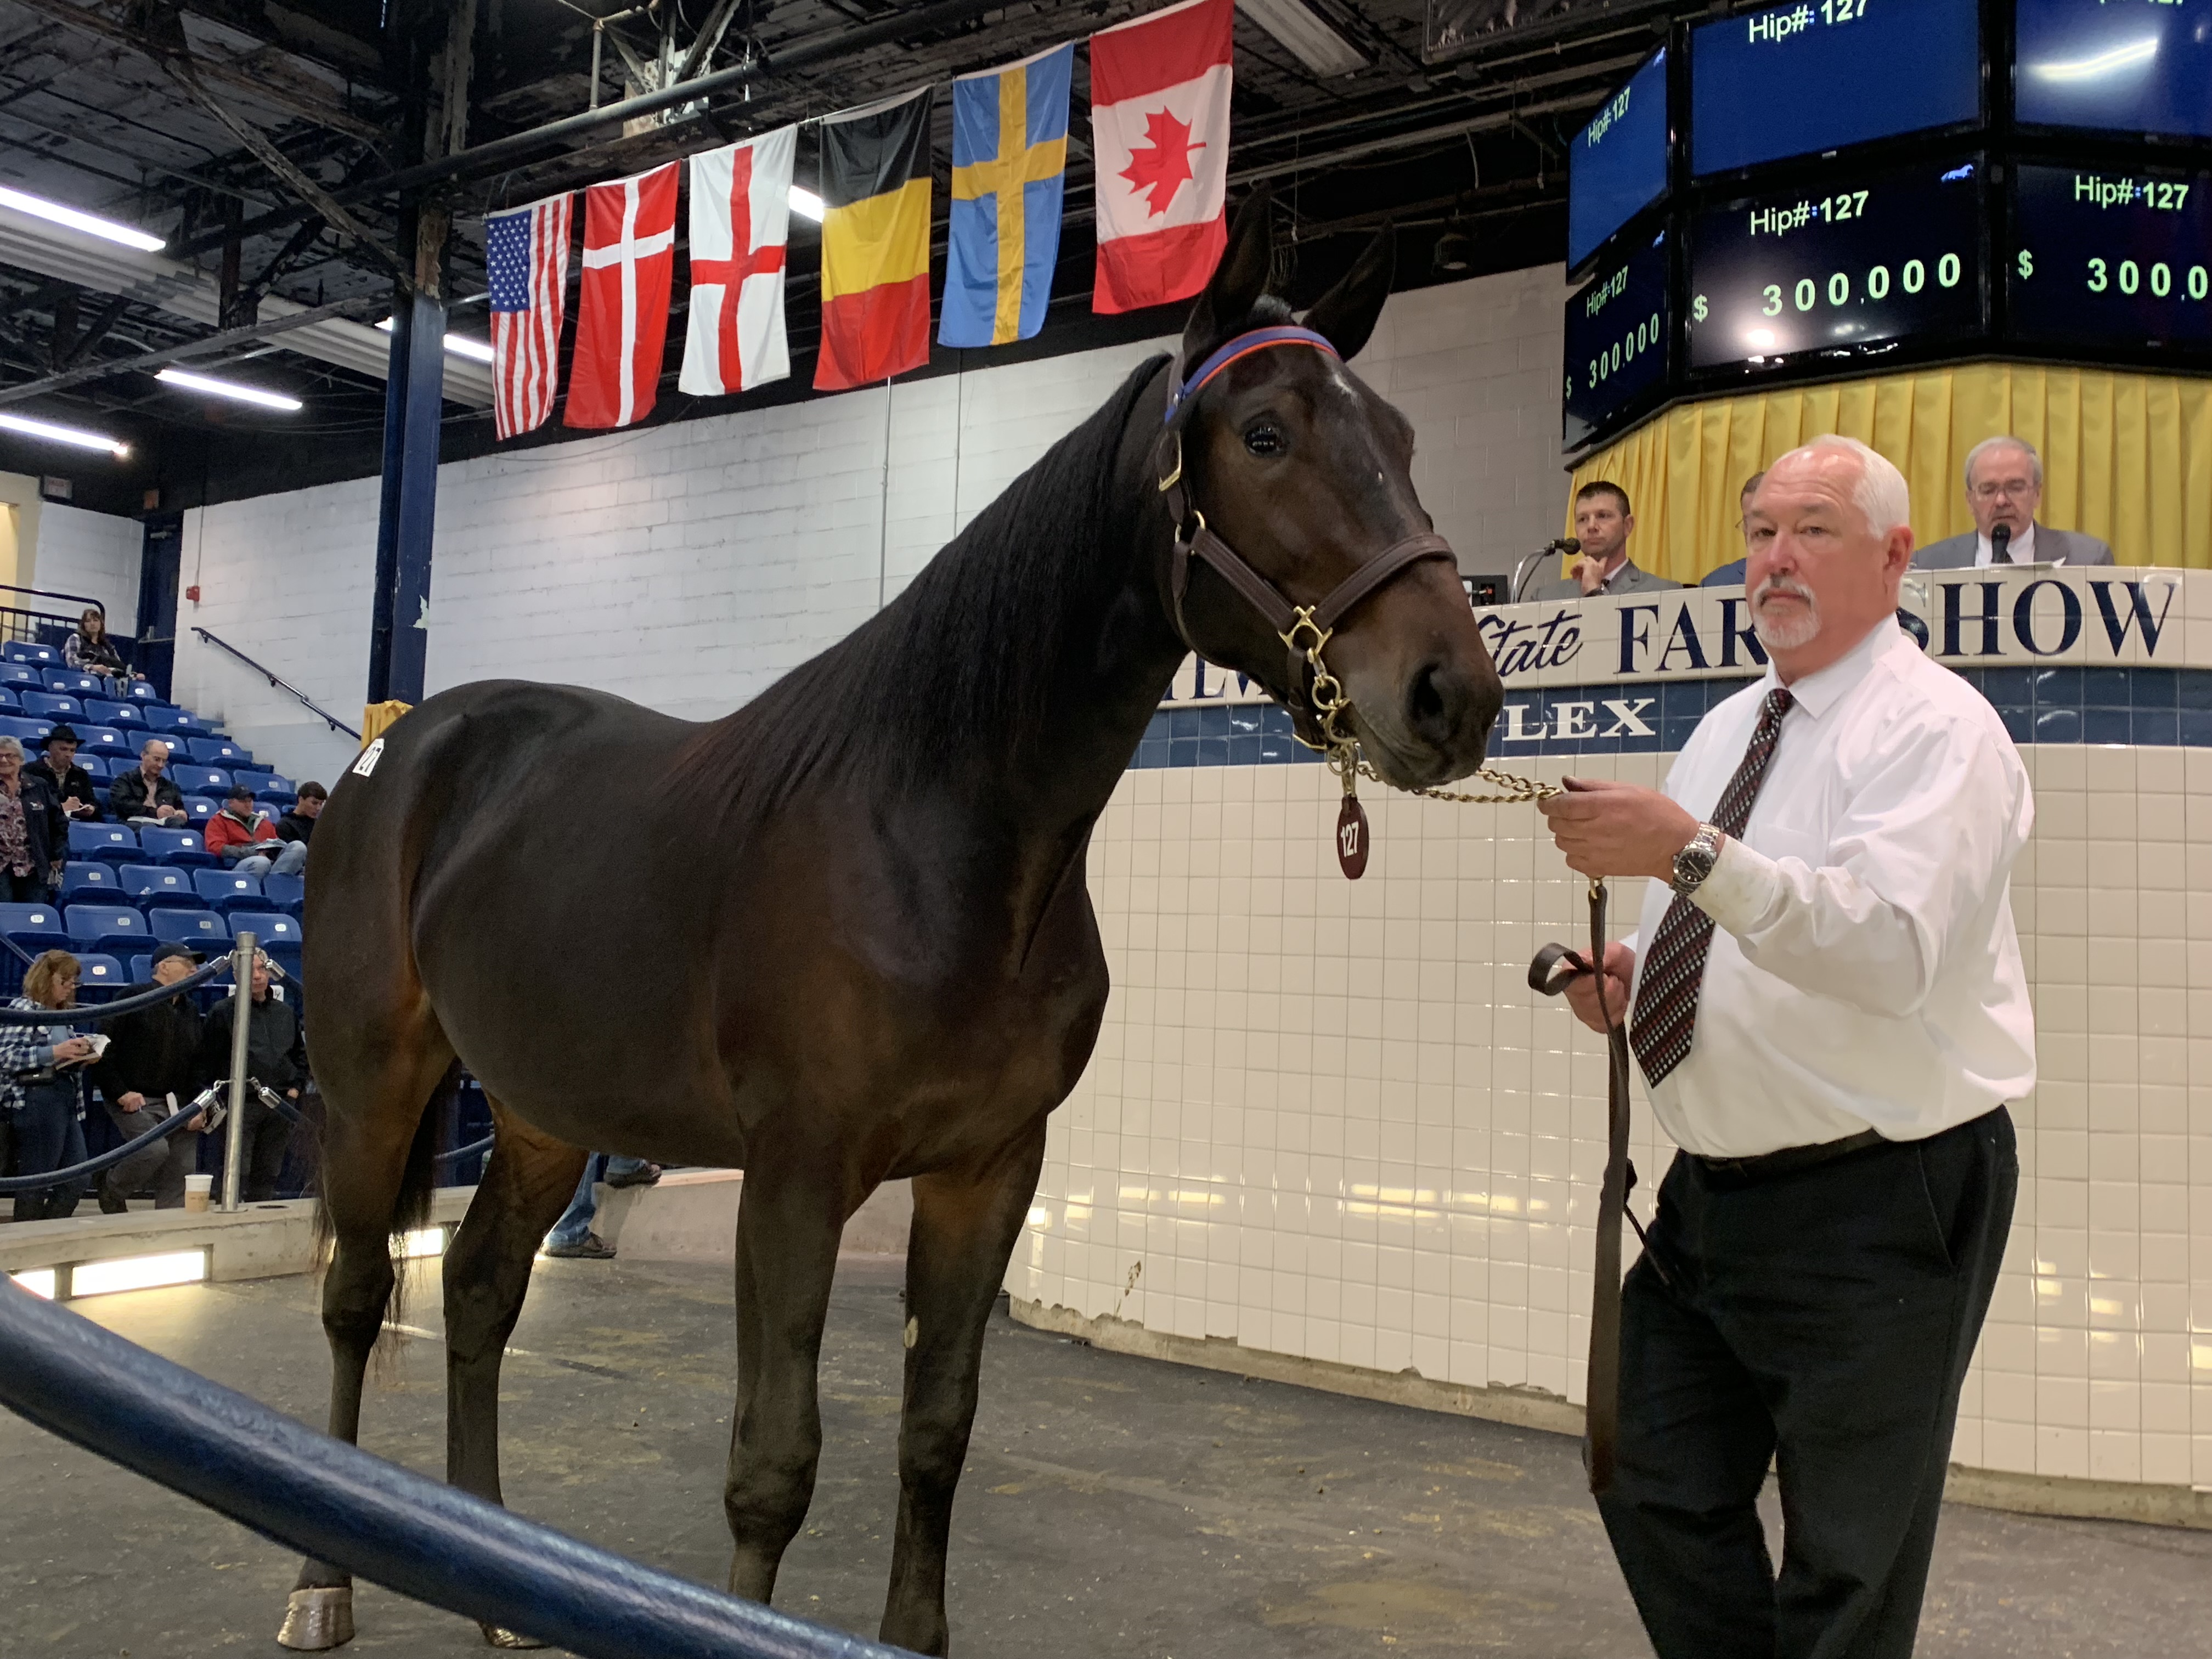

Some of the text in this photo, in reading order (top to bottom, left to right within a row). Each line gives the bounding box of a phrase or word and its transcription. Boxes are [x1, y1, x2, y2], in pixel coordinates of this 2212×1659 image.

[1613, 86, 1630, 122] 127
[1820, 190, 1869, 223] 127
[2143, 182, 2189, 210] 127
[2018, 249, 2033, 280] $
[1694, 294, 1708, 323] $
[1613, 598, 1769, 674] FAR
[1502, 698, 1656, 741] LEX
[1340, 821, 1359, 857] 127
